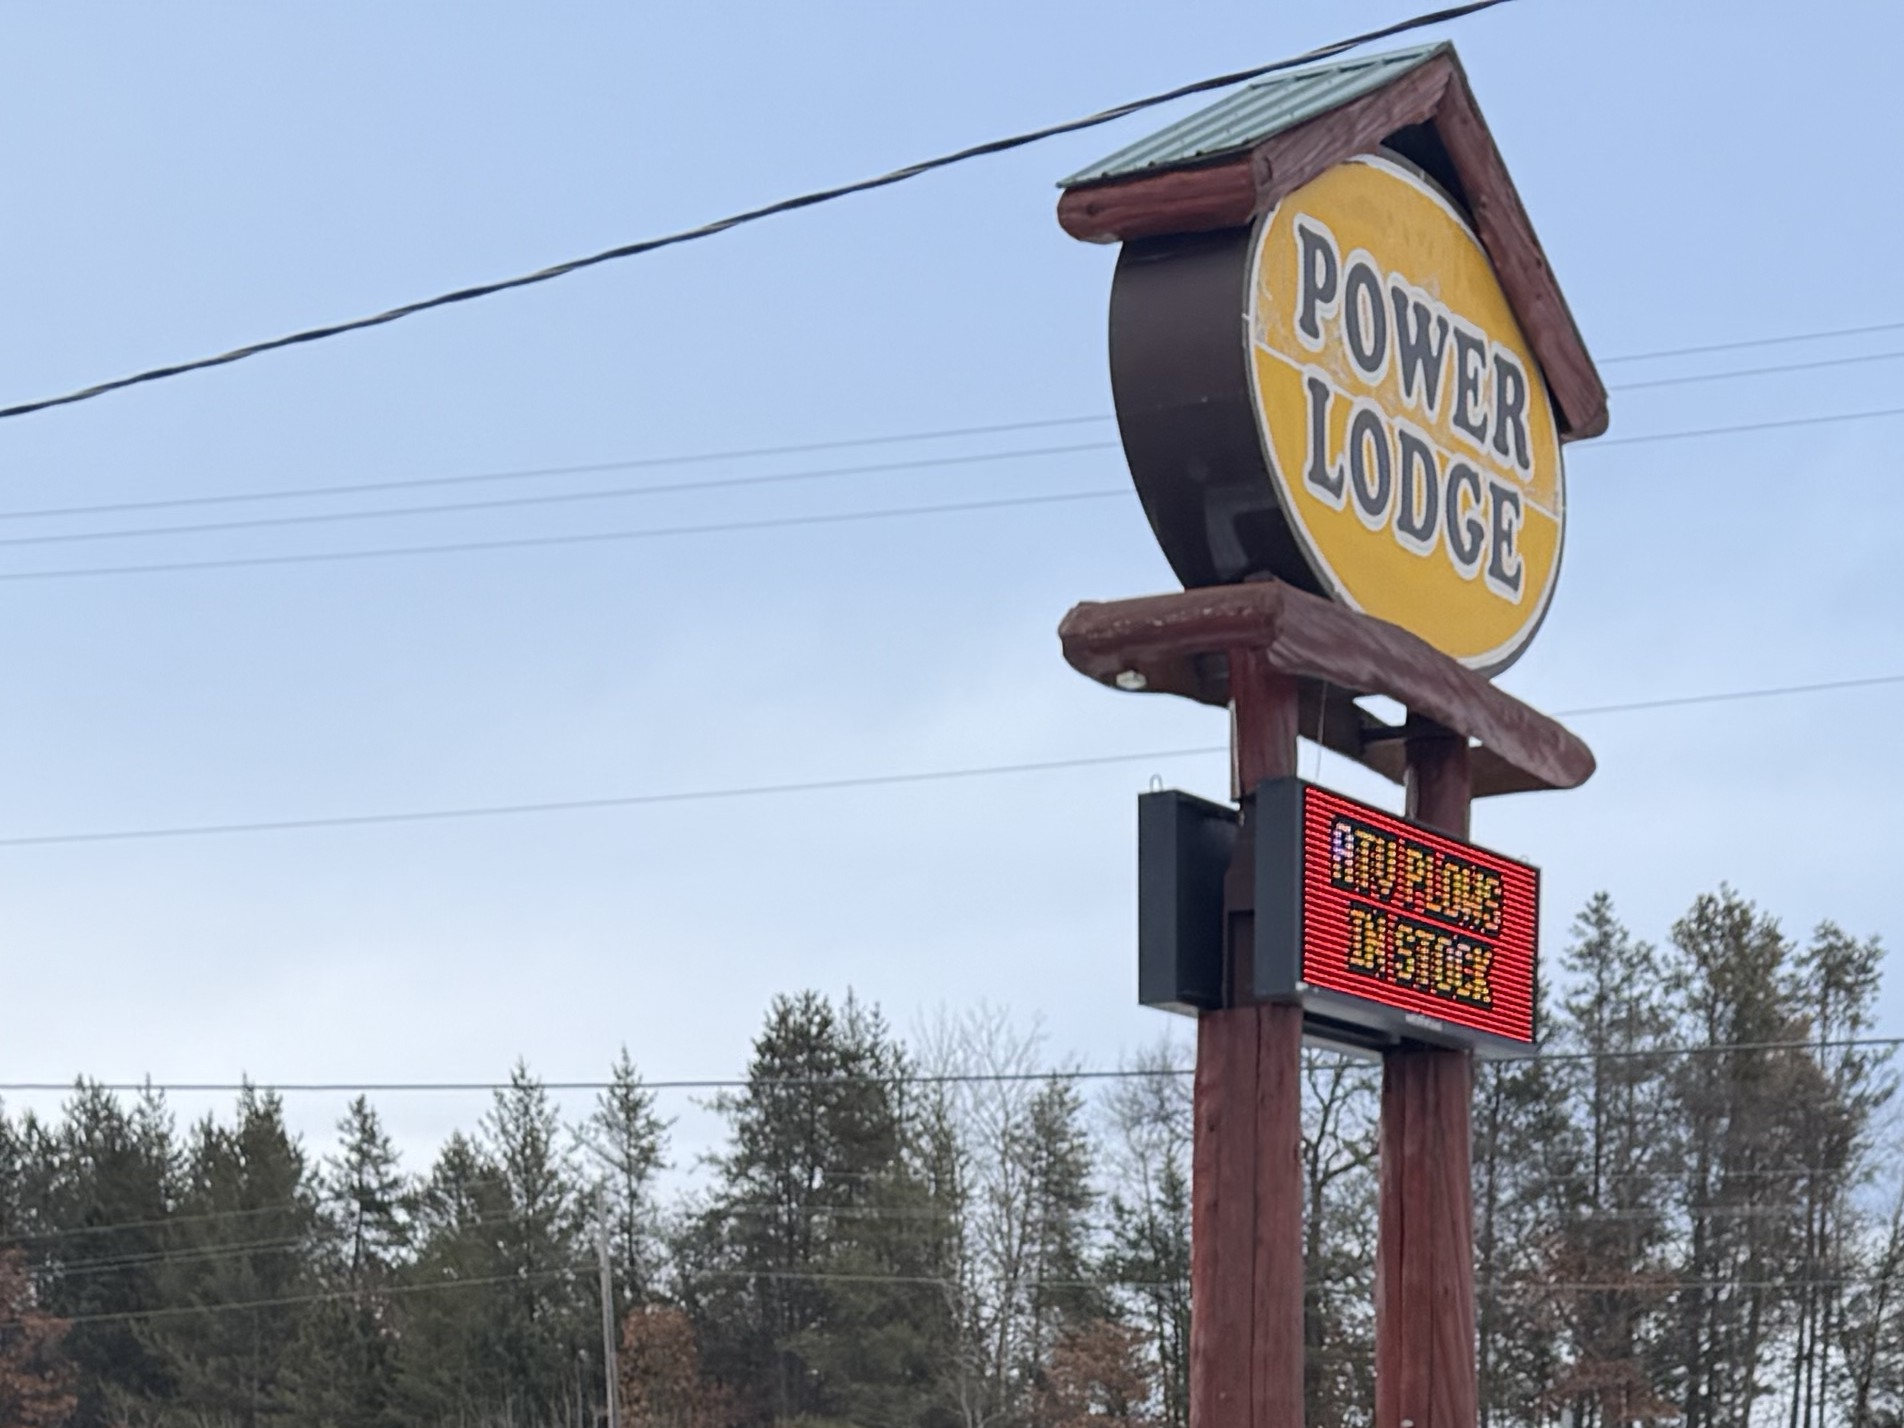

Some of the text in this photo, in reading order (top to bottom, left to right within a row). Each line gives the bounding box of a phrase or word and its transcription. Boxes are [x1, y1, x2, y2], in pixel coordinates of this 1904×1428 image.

[1296, 221, 1532, 472] POWER
[1306, 377, 1524, 594] LODGE
[1332, 822, 1397, 896] ATV
[1350, 907, 1493, 1004] IN STOCK
